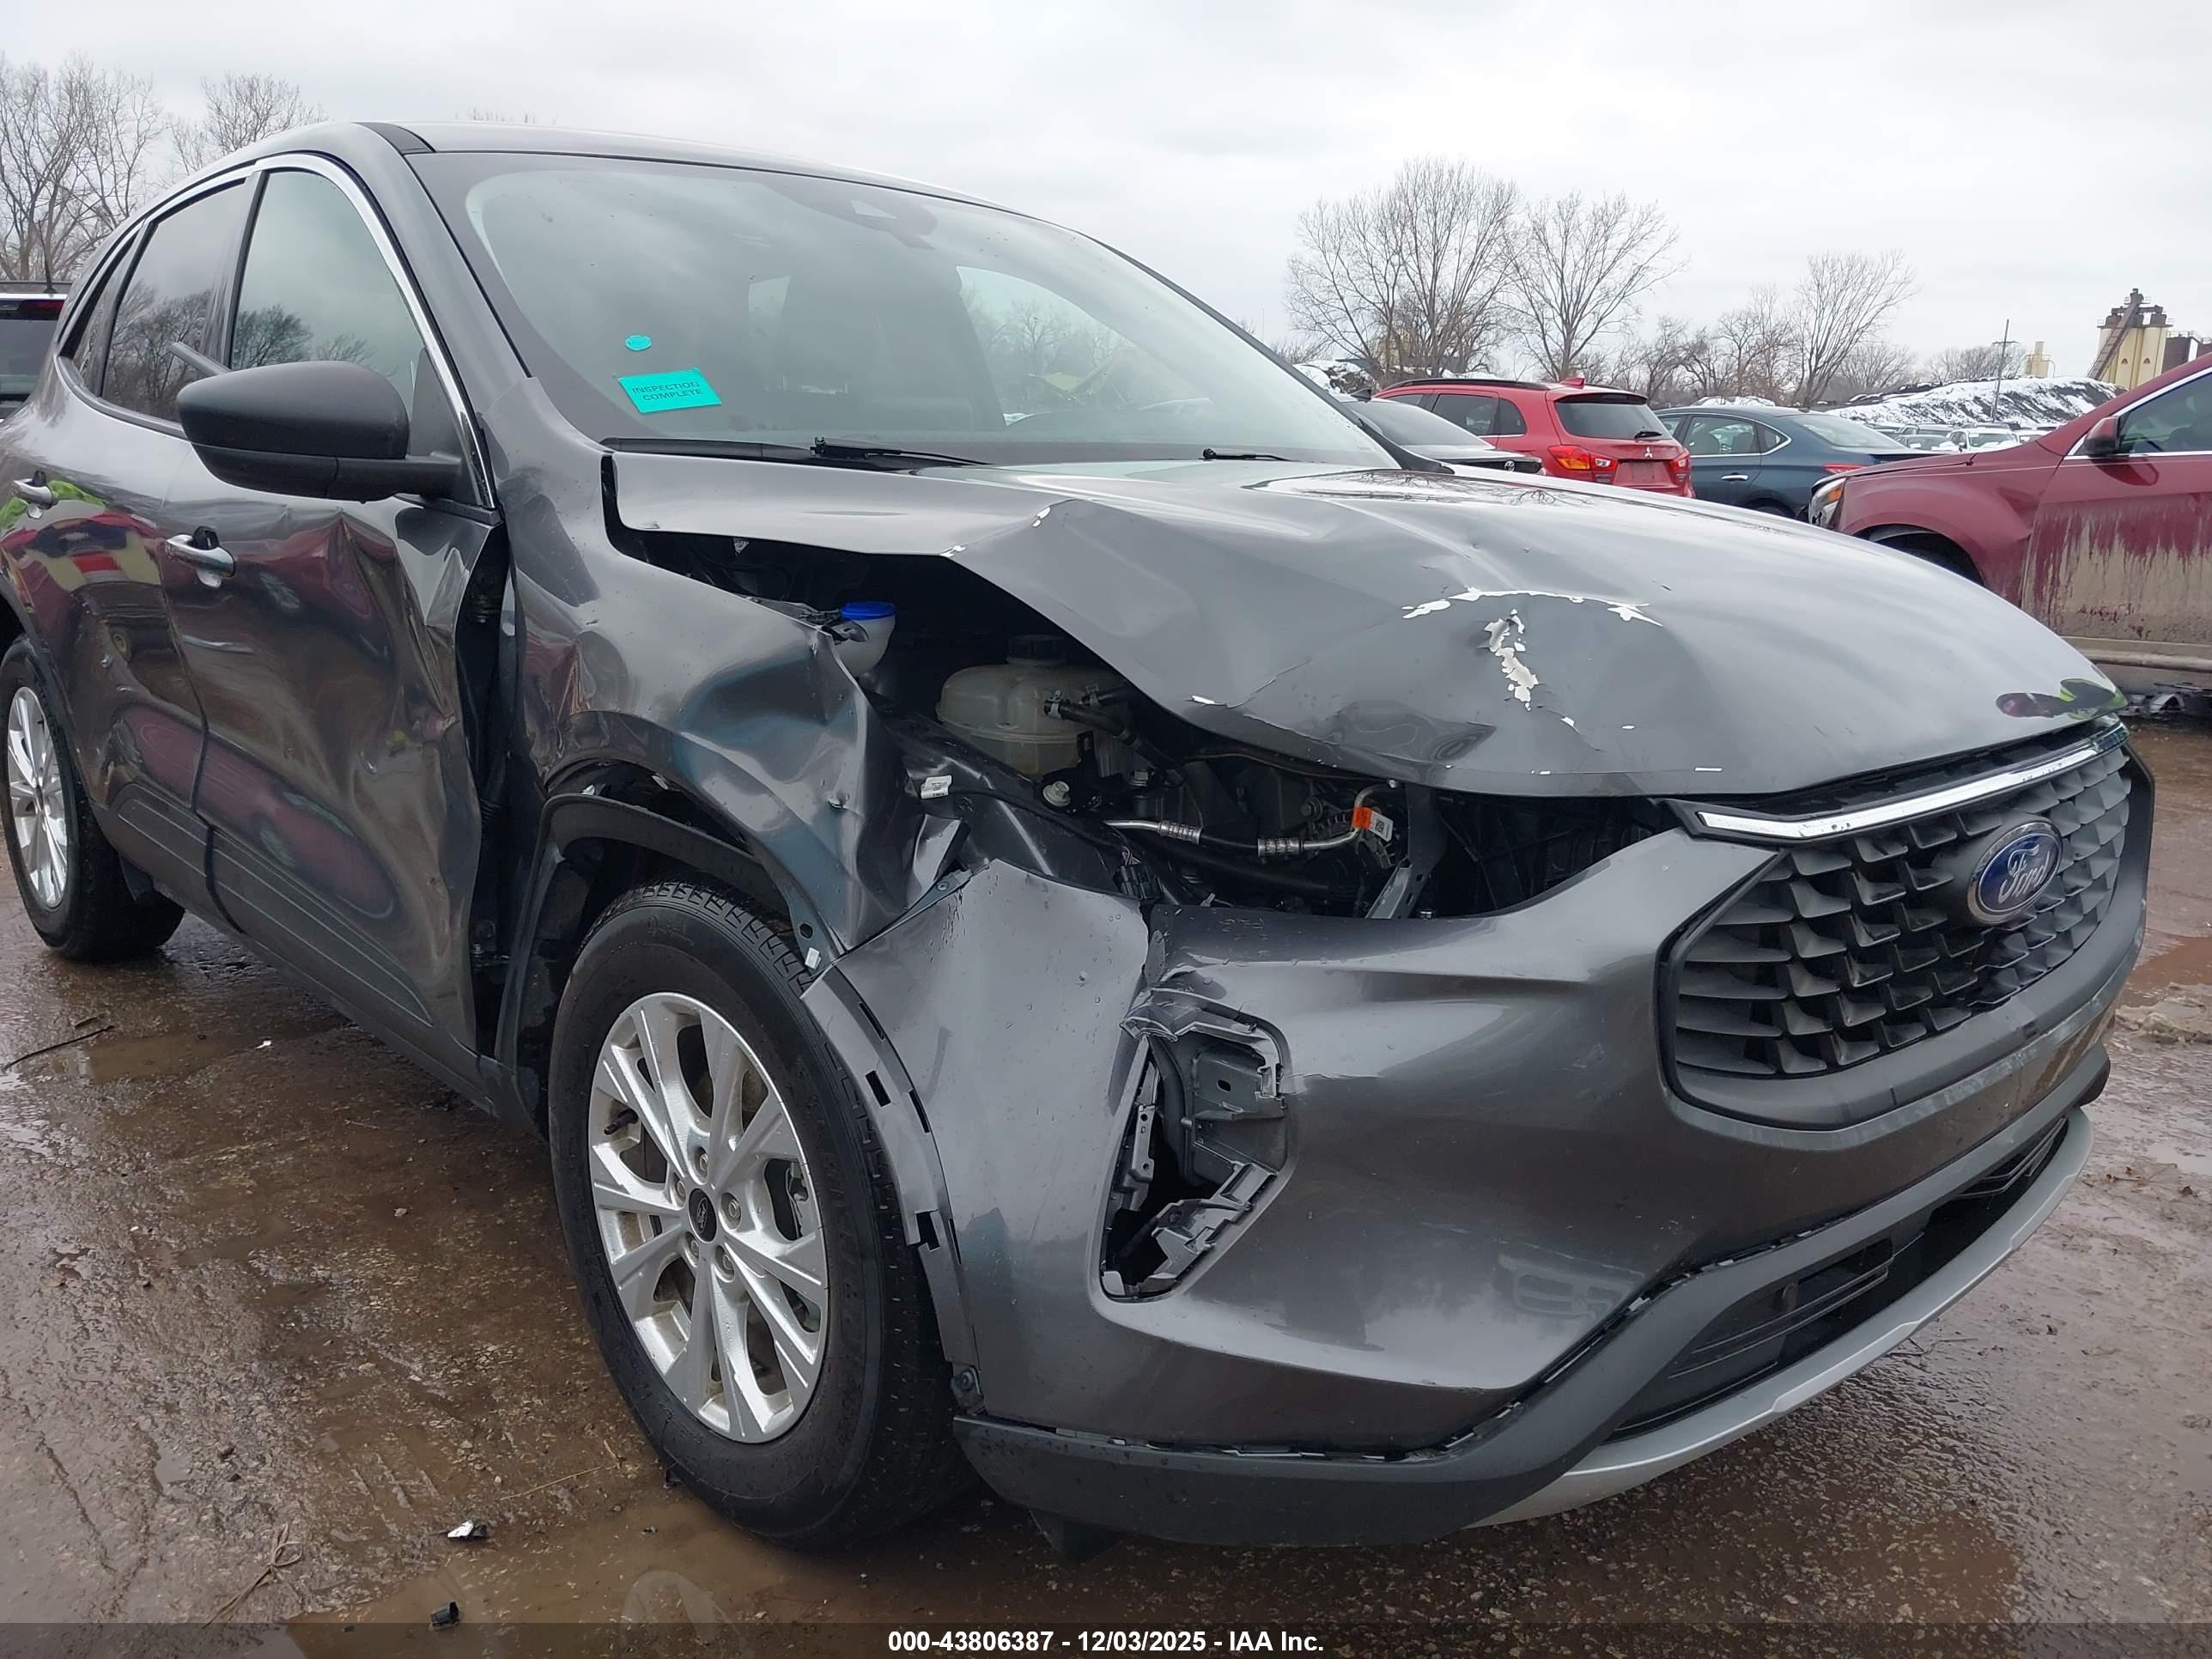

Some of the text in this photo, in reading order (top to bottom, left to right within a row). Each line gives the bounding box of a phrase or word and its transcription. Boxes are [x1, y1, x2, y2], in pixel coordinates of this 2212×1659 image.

[632, 381, 701, 394] INSPECTION
[642, 389, 702, 401] COMPLETE
[1997, 844, 2051, 904] Ford
